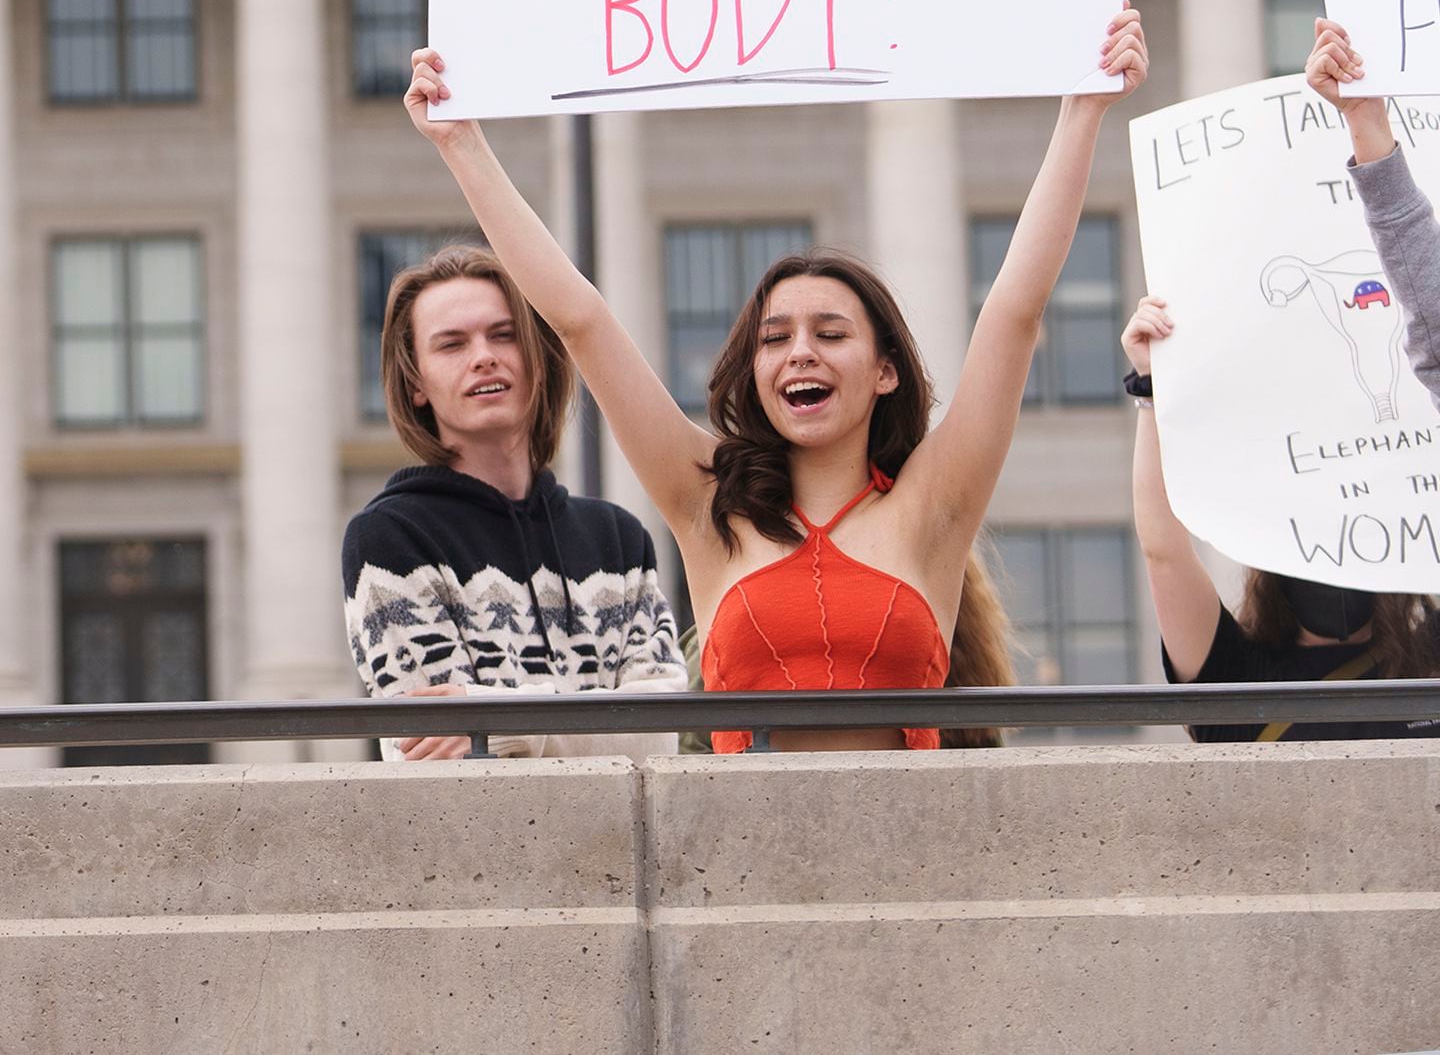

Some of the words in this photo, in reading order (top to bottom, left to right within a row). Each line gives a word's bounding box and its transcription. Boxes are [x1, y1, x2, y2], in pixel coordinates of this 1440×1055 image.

[1153, 109, 1245, 190] LETS
[1286, 426, 1440, 474] ELEPHAN
[1340, 481, 1370, 499] IN
